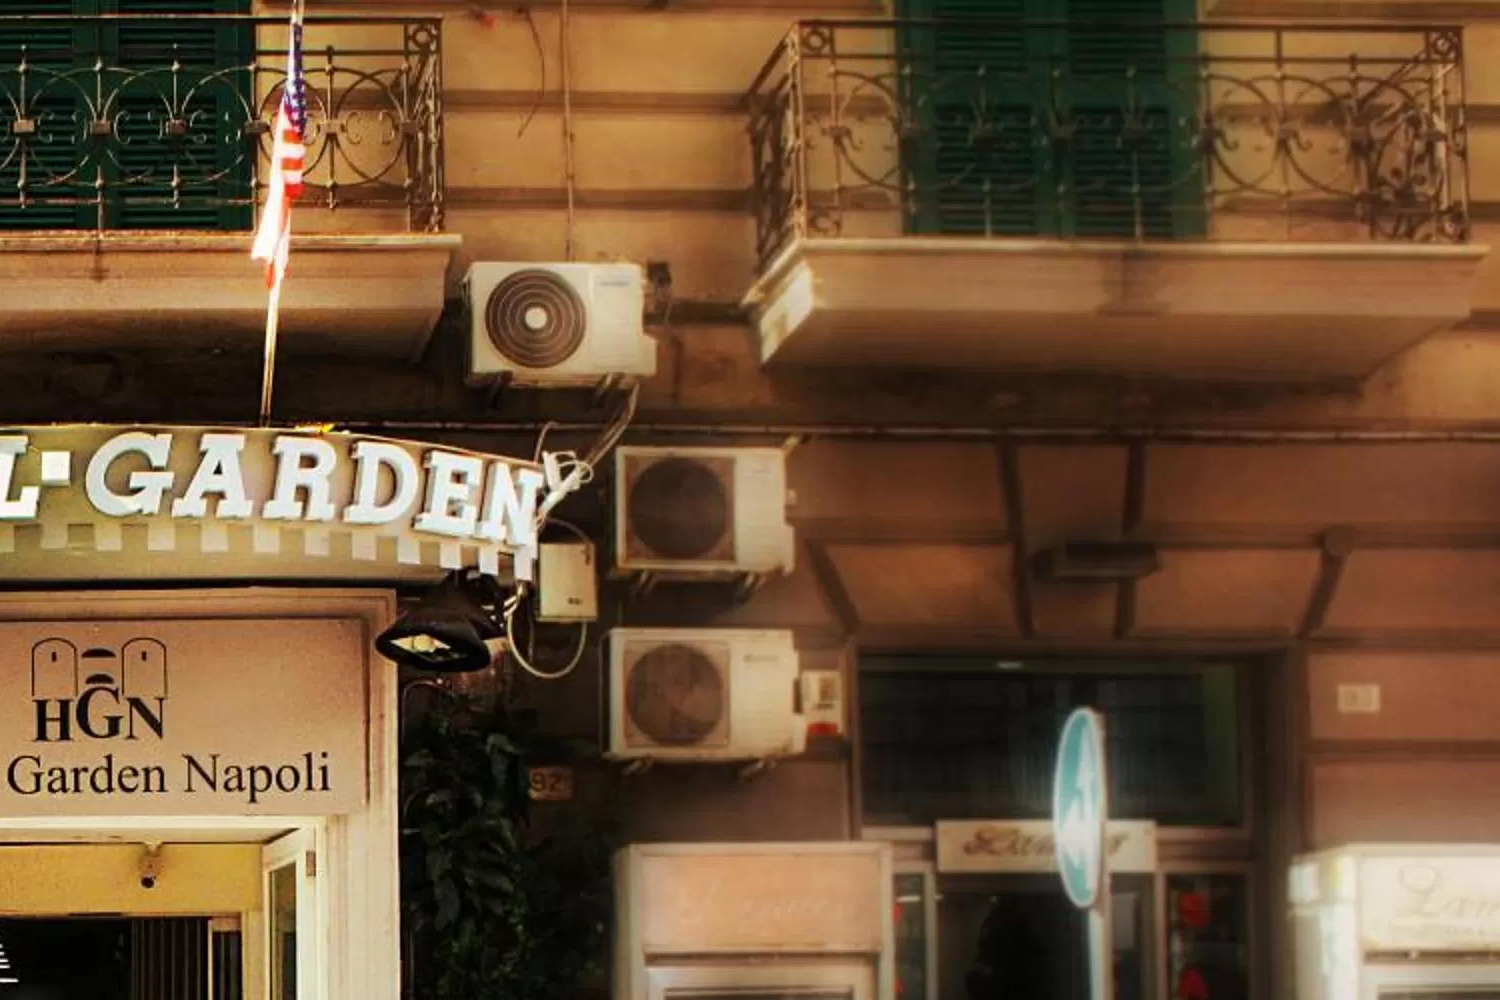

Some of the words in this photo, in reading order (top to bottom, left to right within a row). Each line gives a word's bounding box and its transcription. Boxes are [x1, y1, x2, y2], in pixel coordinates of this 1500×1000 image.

[84, 431, 544, 546] GARDEN
[32, 686, 167, 742] HGN
[7, 753, 168, 795] Garden
[182, 751, 331, 804] Napoli
